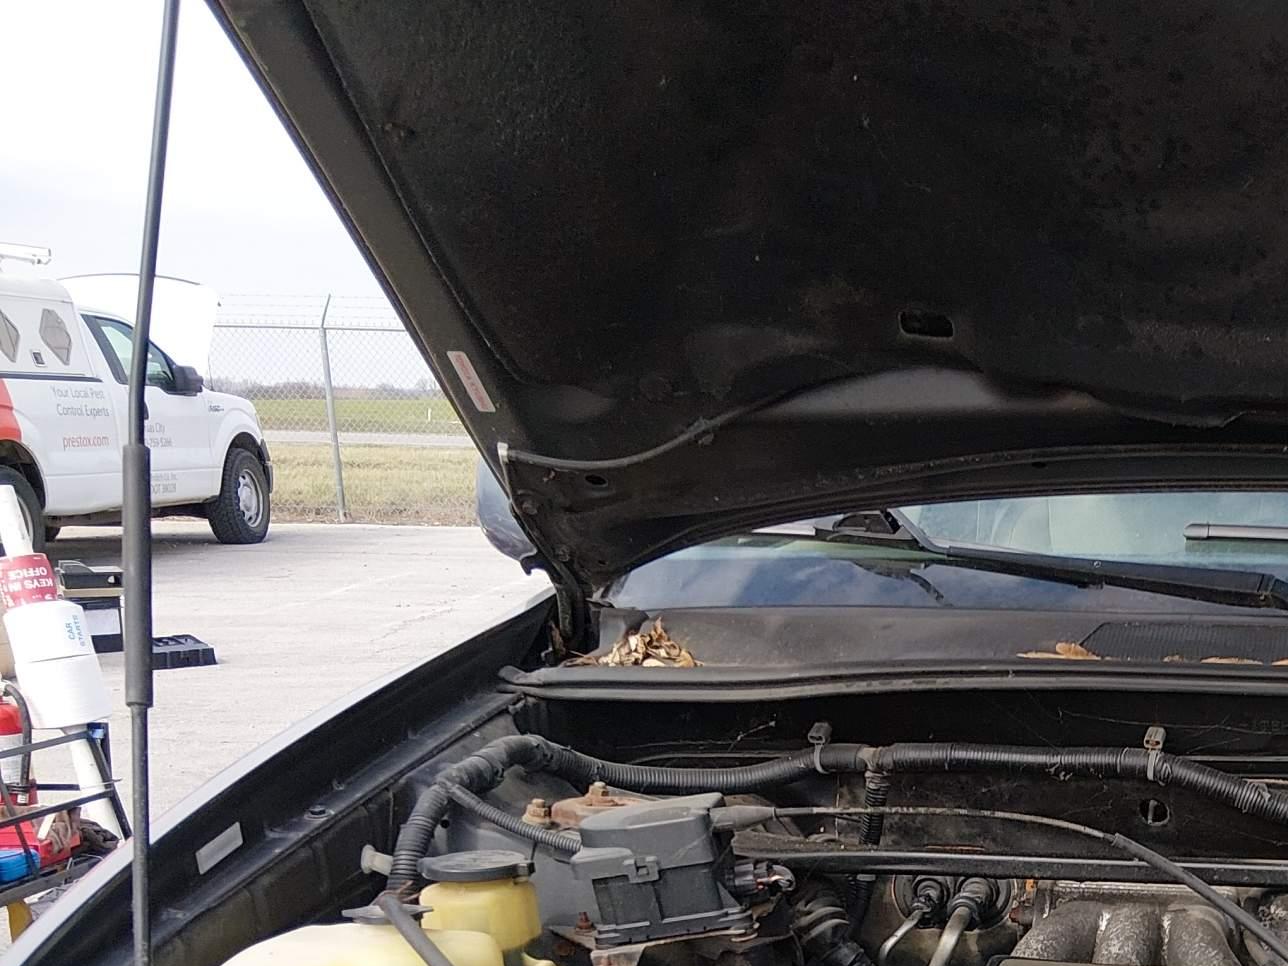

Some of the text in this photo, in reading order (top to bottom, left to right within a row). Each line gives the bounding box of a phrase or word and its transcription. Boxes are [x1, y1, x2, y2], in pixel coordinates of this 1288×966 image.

[51, 386, 69, 398] Your
[71, 387, 89, 398] Local
[56, 404, 110, 420] Control Experts
[63, 436, 110, 451] prestox.com
[9, 567, 48, 579] OFFICE
[24, 578, 53, 590] KEYS
[66, 623, 75, 640] CAR
